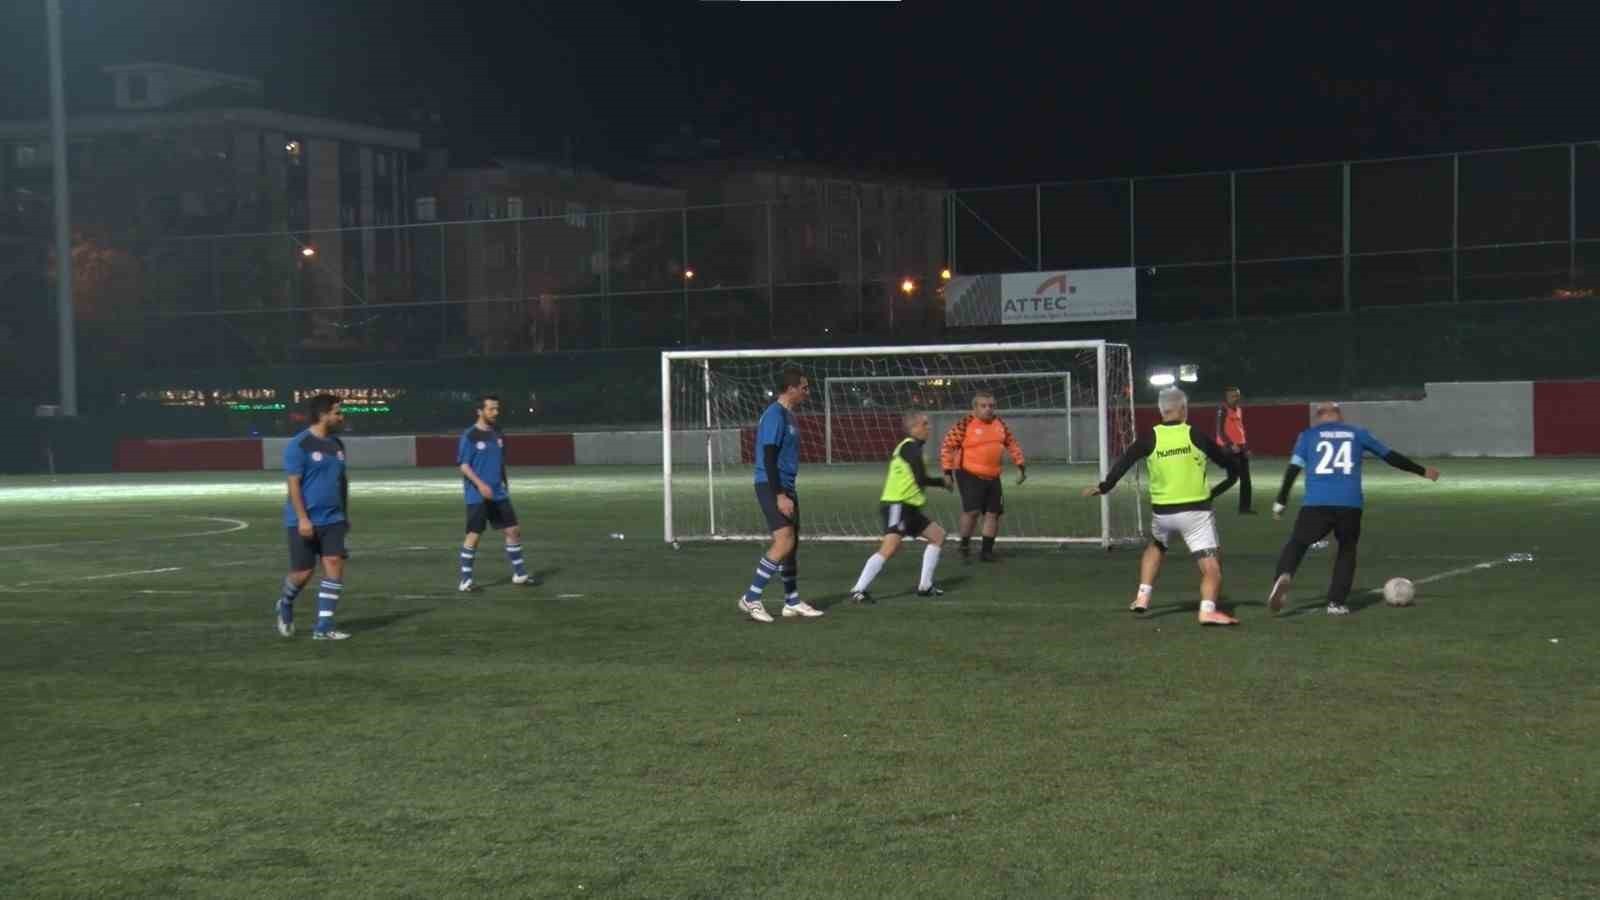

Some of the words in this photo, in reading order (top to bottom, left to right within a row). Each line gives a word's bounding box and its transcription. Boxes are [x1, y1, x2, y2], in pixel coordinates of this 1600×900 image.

[1004, 297, 1068, 312] ATTEC
[1156, 444, 1191, 458] hummel
[1315, 440, 1354, 475] 24
